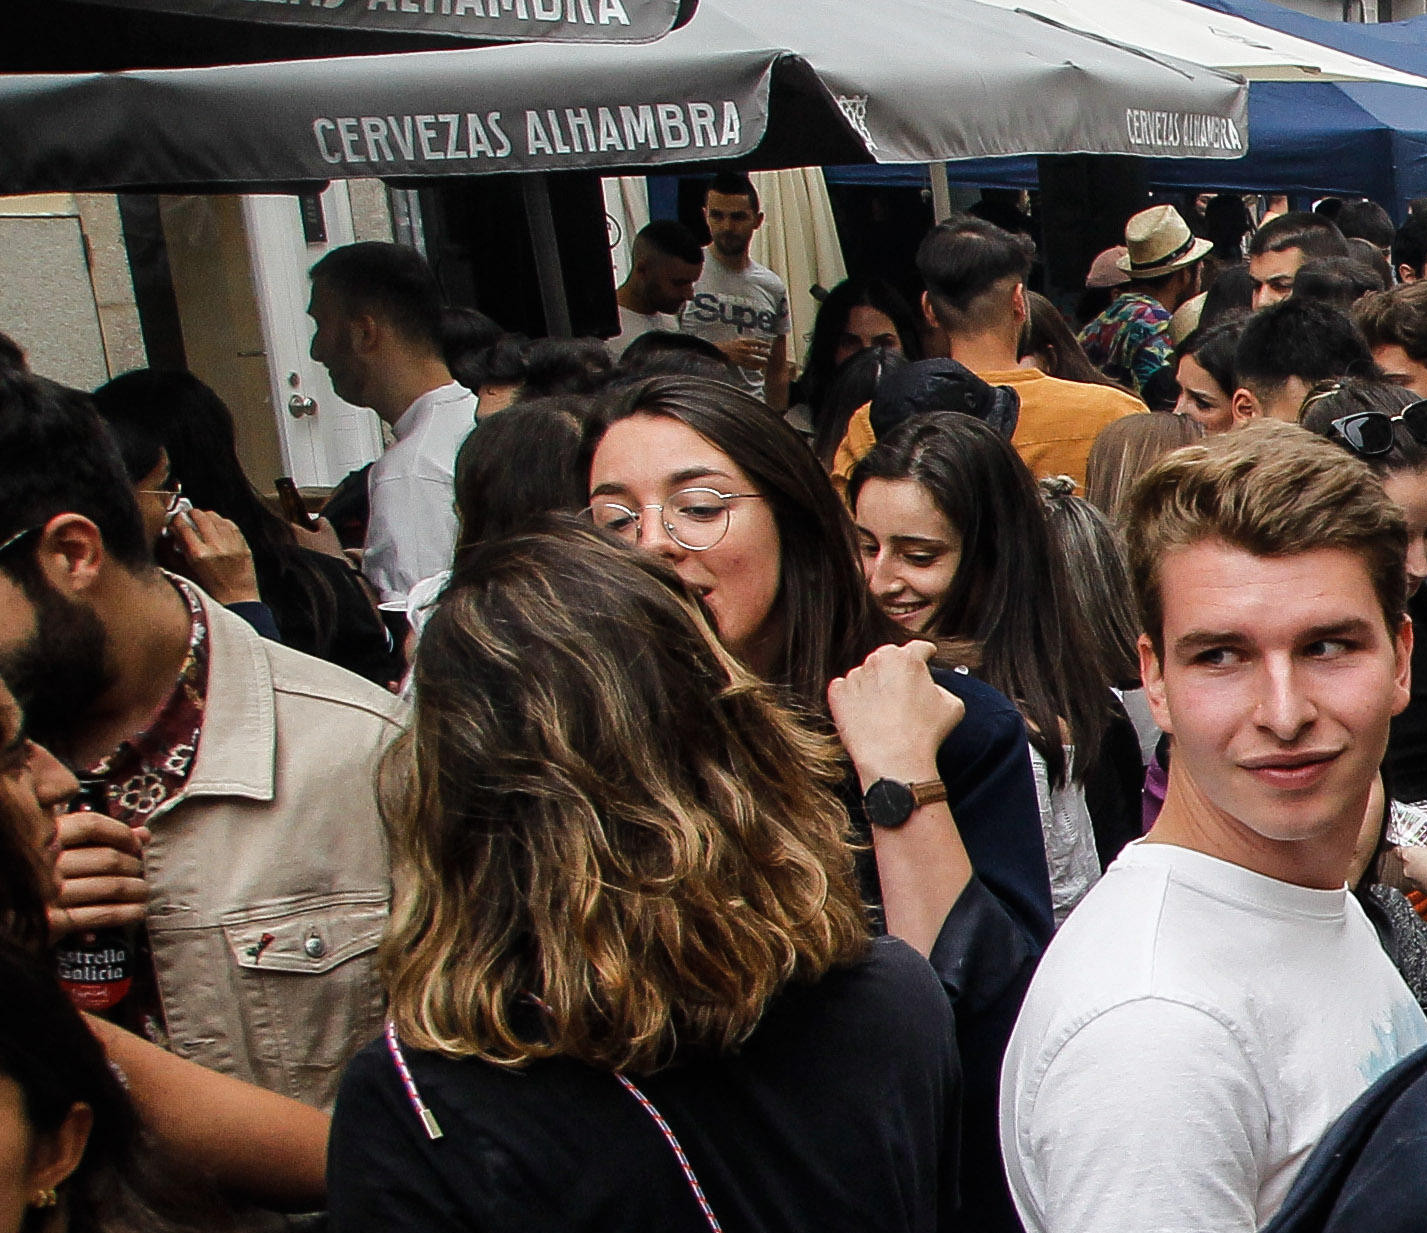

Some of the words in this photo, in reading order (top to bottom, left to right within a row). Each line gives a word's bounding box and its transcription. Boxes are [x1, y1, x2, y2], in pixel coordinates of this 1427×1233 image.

[312, 111, 512, 164] CERVEZAS
[525, 101, 741, 156] ALHAMBRA
[1126, 108, 1180, 146] CERVEZAS
